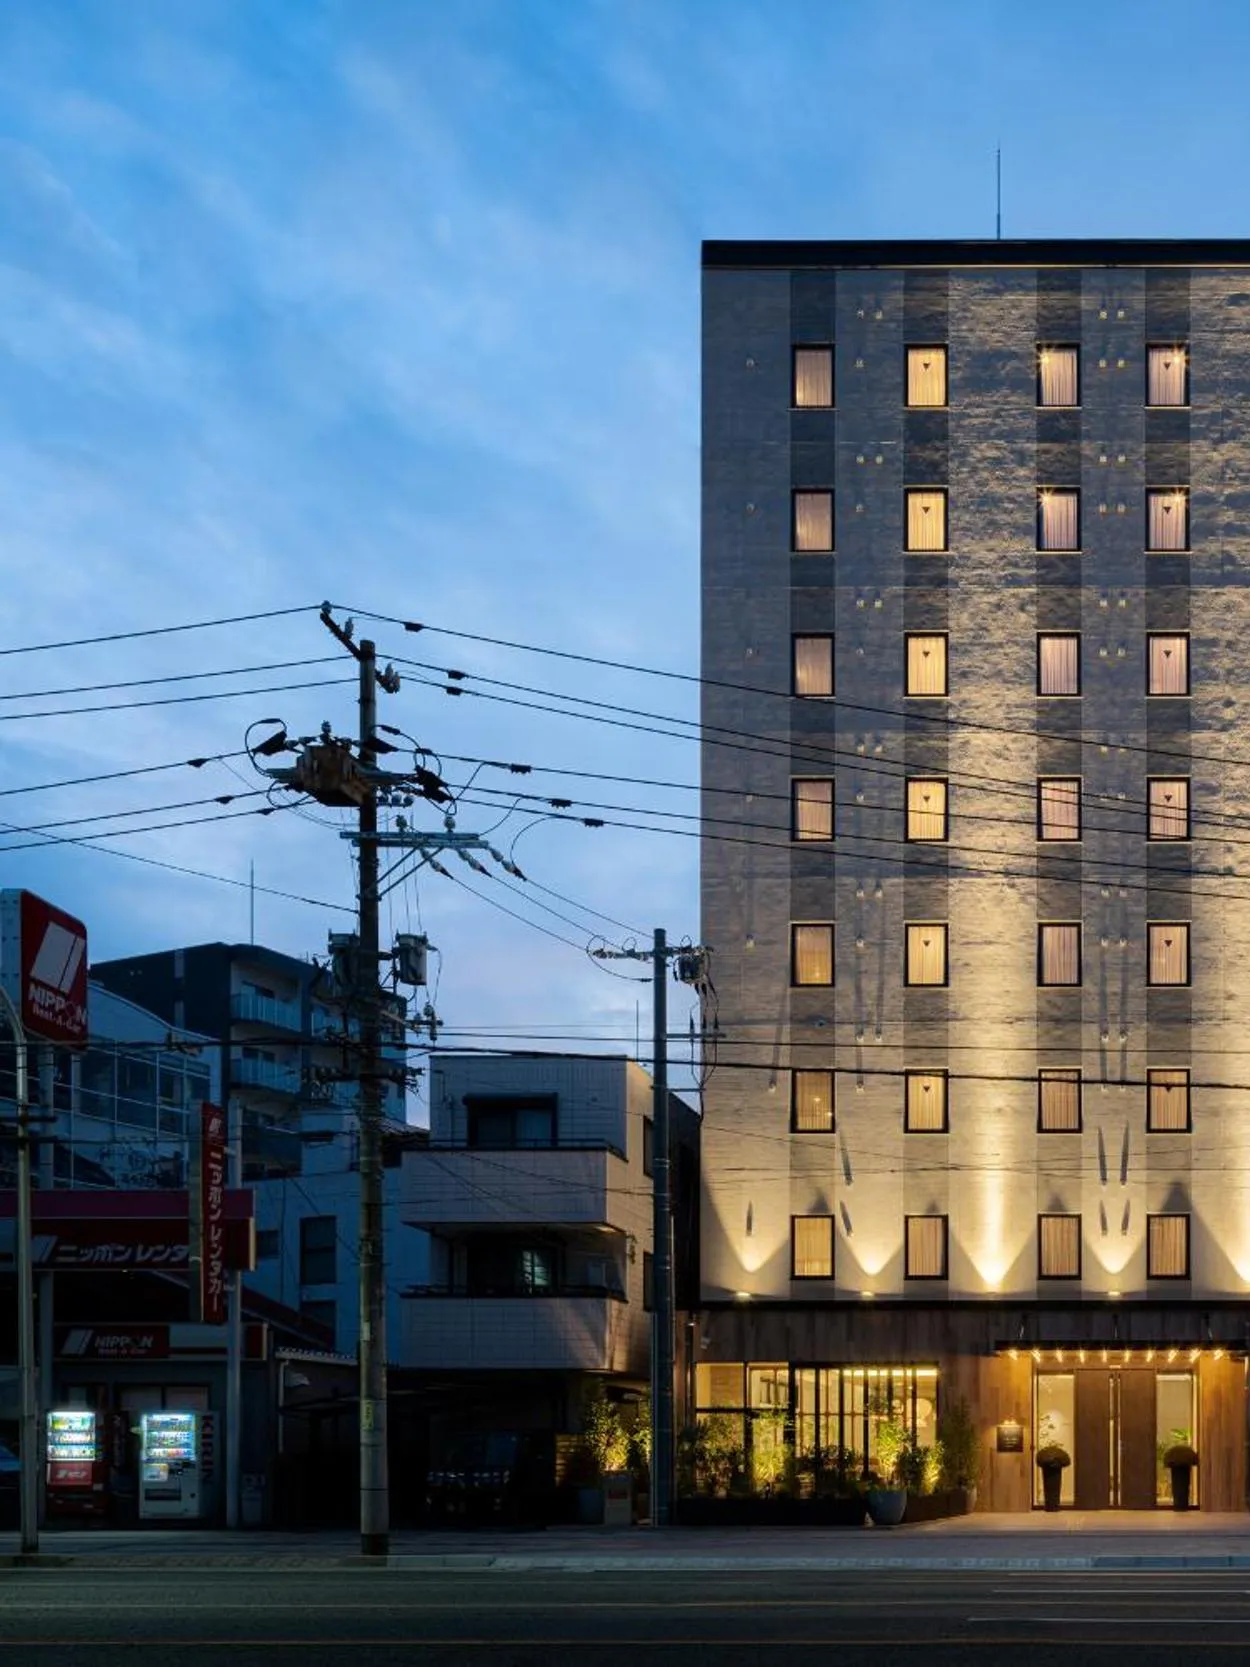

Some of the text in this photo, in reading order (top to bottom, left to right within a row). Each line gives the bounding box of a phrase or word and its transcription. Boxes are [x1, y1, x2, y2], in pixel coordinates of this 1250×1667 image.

[28, 982, 87, 1027] NIPPON
[54, 1241, 190, 1264] ニッポンレンタ
[94, 1335, 154, 1349] NIPPON
